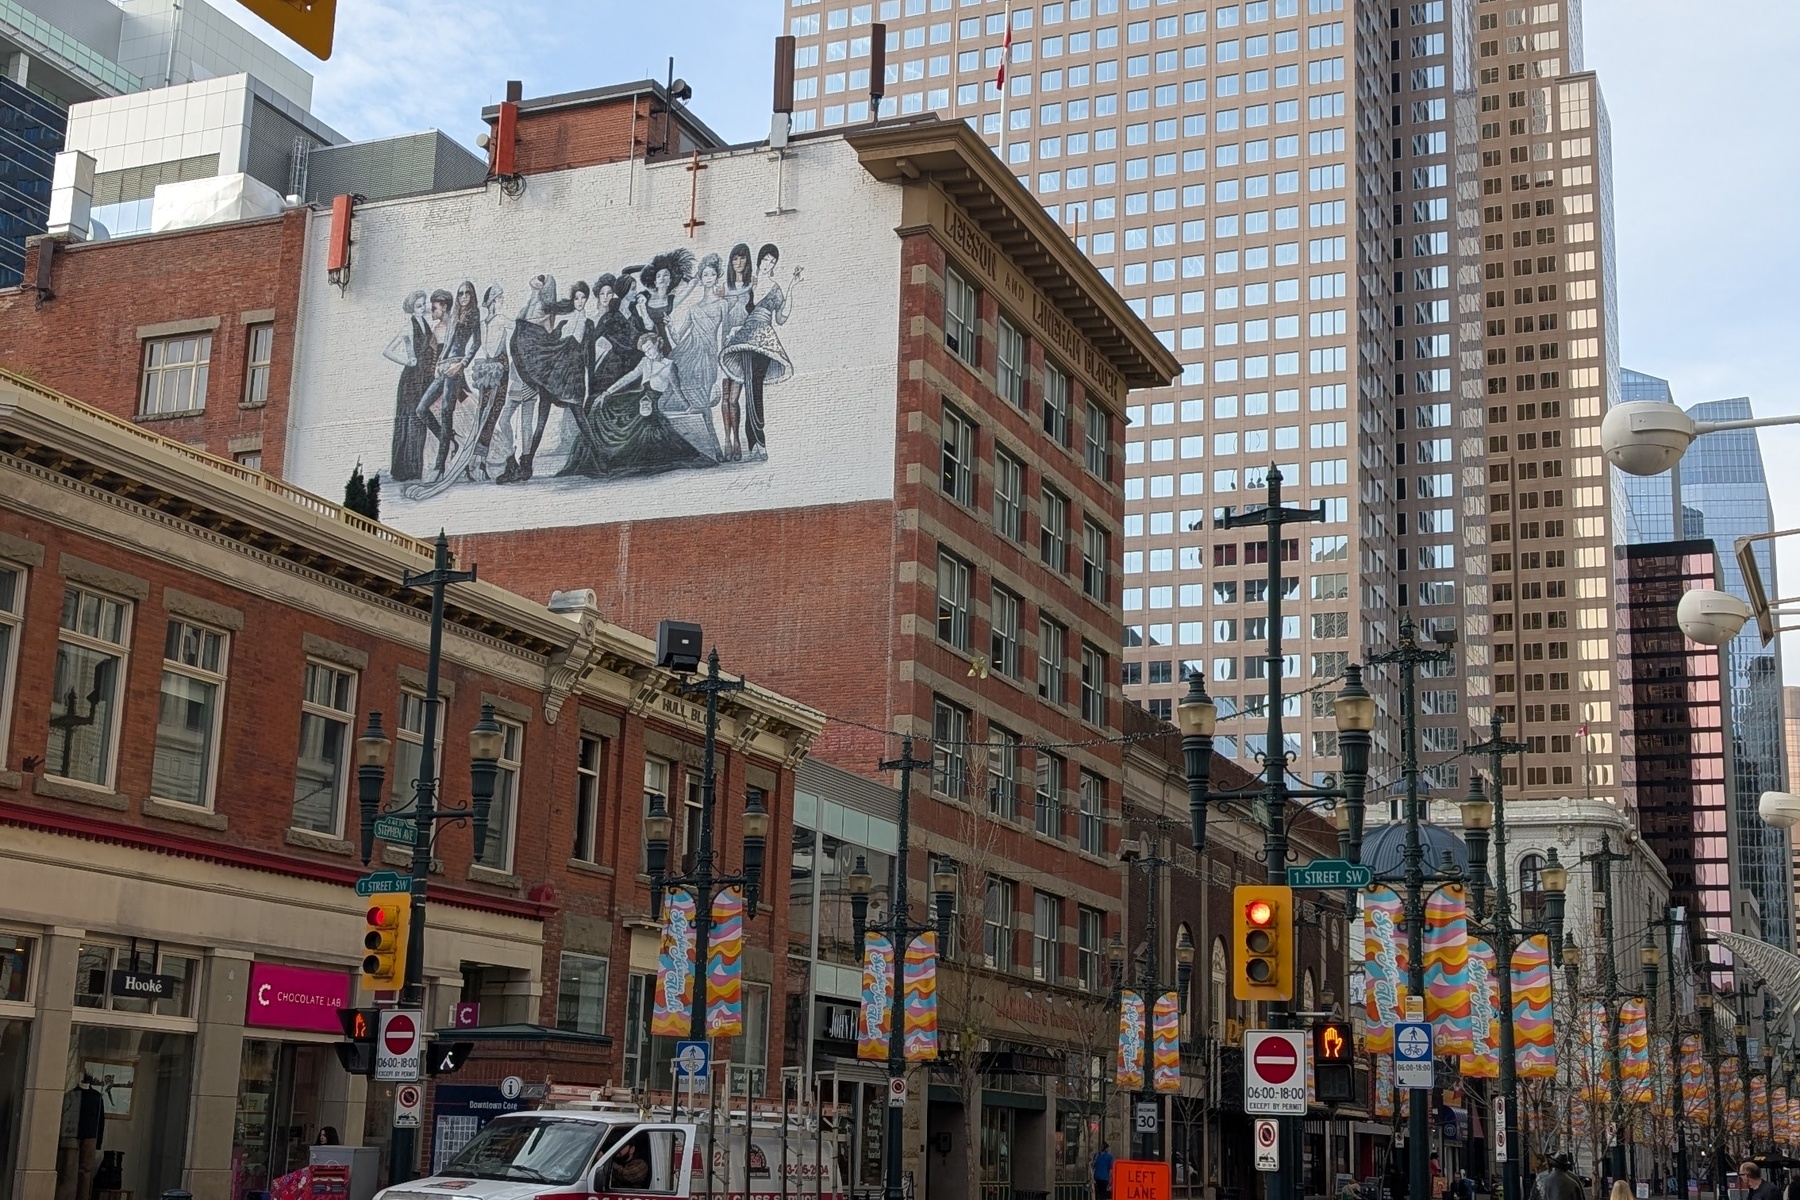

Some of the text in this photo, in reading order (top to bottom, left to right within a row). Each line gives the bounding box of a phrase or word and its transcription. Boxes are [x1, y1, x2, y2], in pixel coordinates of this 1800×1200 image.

[944, 203, 997, 281] LEESON
[1005, 272, 1025, 302] AND
[1084, 345, 1118, 401] BLOCK
[662, 698, 721, 731] HULL BLK
[378, 824, 414, 841] STEPHEN AVE
[1294, 870, 1363, 884] 1 STREET SW
[361, 880, 408, 892] 1 STREET SW
[124, 976, 163, 994] Hooké
[277, 991, 342, 1007] CHOCOLATE LAB
[469, 1100, 518, 1110] Downtown Core
[1249, 1102, 1270, 1110] EXCEPT
[1282, 1103, 1302, 1111] PERMIT
[1138, 1115, 1156, 1128] 30
[1686, 1133, 1700, 1142] 30
[1128, 1170, 1156, 1183] LEFT
[1127, 1187, 1156, 1200] LANE
